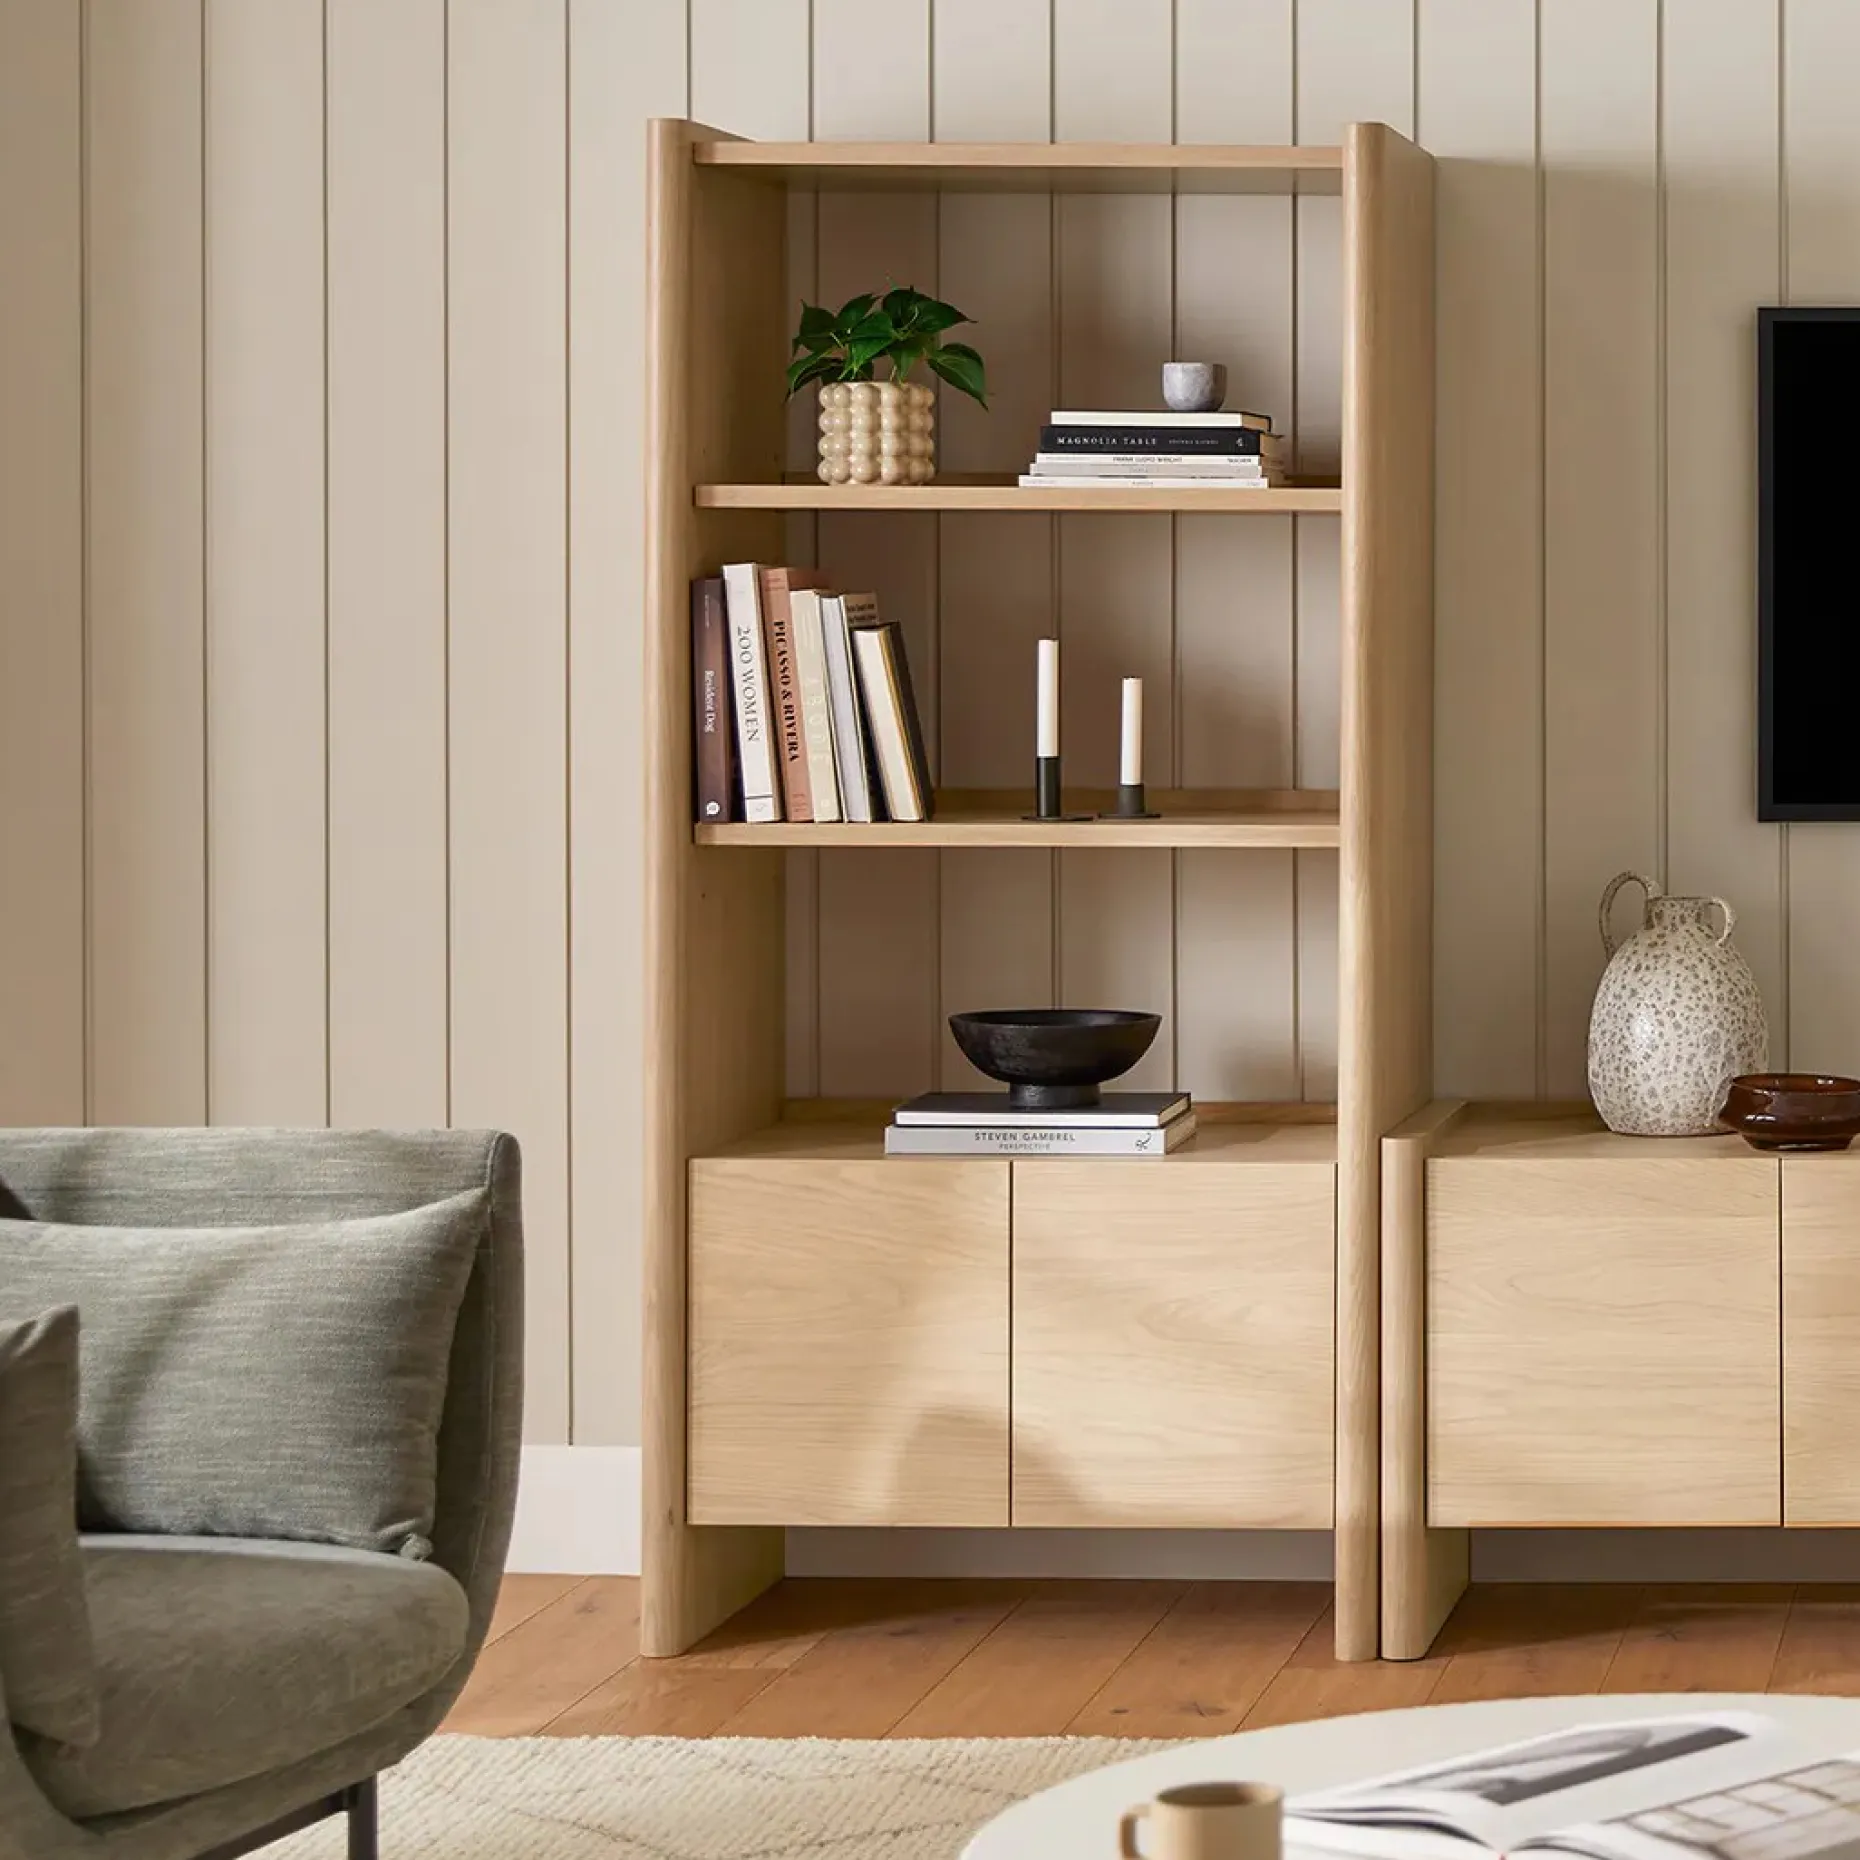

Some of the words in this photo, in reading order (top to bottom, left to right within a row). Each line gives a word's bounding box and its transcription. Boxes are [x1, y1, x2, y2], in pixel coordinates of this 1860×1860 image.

[1057, 437, 1118, 445] MAGNOLIA
[1124, 437, 1157, 445] TABLE
[773, 620, 791, 686] PICASSO
[742, 668, 760, 741] WOMEN
[781, 688, 793, 700] &
[704, 712, 716, 733] Dog
[783, 704, 800, 762] RIVERA
[975, 1132, 1018, 1141] STEVEN
[1022, 1132, 1076, 1141] GAMBREL
